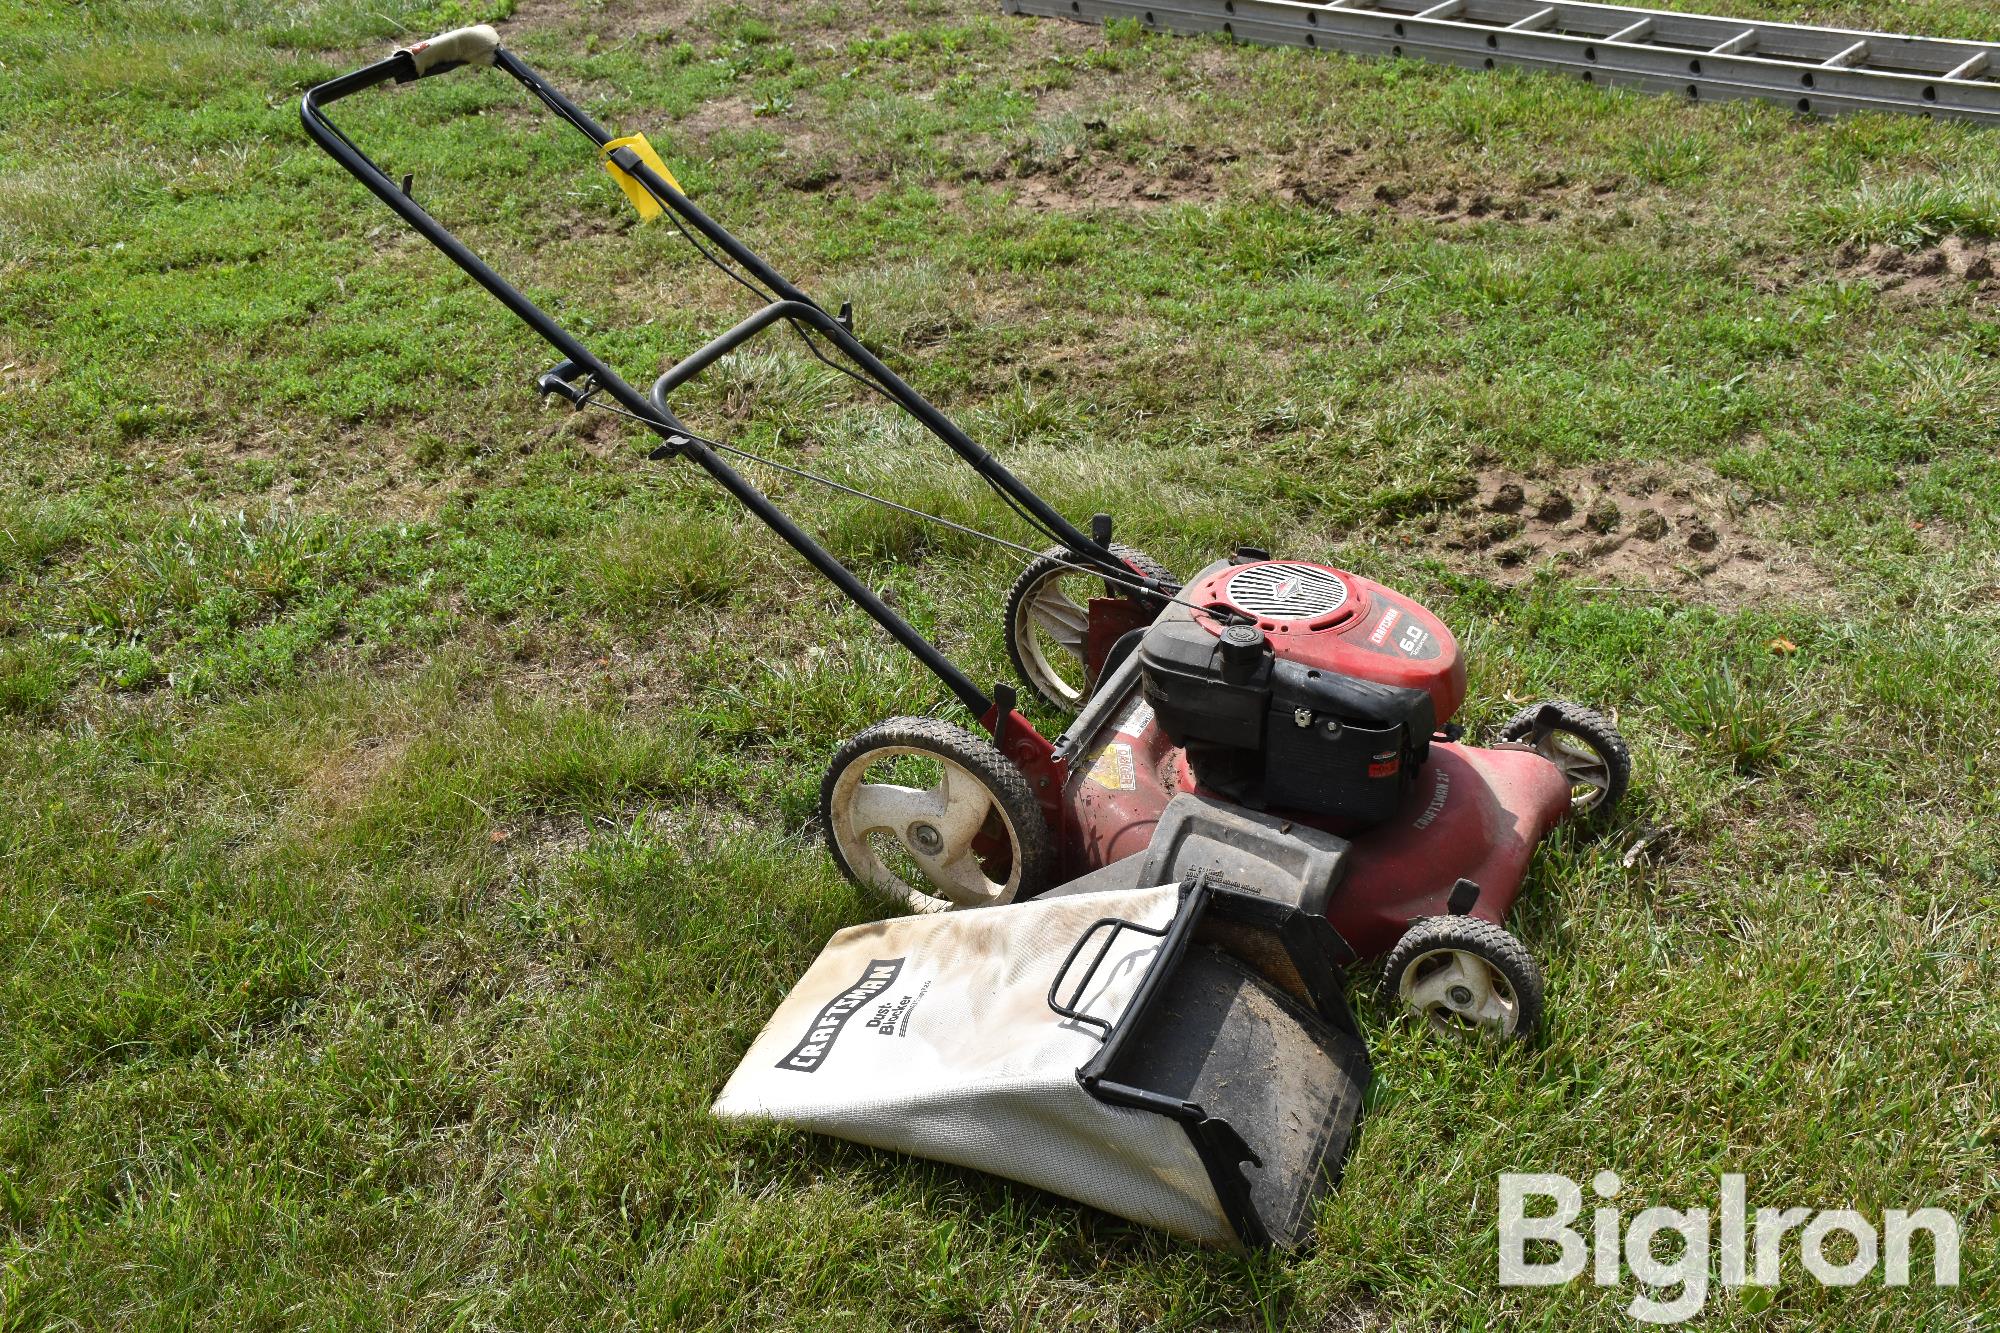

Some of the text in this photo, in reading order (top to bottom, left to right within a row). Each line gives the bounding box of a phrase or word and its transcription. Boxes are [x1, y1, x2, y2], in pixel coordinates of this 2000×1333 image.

[1400, 625, 1422, 651] 6.0
[1412, 784, 1448, 829] CRAFTSMAN
[789, 965, 897, 1068] CRAFTSMAN
[878, 995, 912, 1035] Blocker
